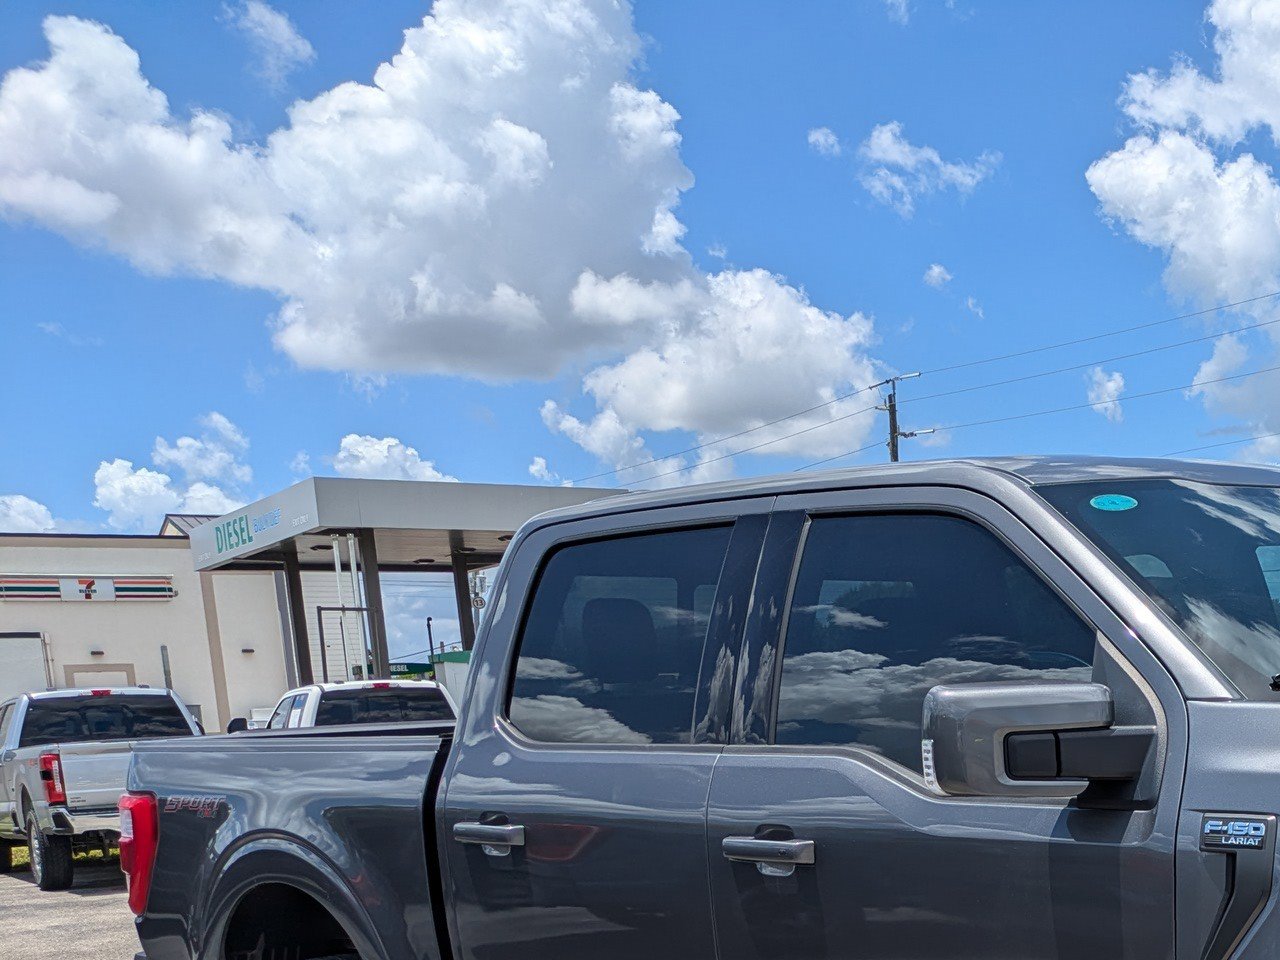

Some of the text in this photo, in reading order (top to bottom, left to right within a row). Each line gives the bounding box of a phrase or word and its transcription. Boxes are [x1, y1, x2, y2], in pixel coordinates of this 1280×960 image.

[214, 515, 254, 555] DIESEL
[390, 664, 409, 672] IESEL
[164, 795, 227, 812] SPORT
[1204, 820, 1266, 836] F-150
[1221, 836, 1262, 846] LARIAT
